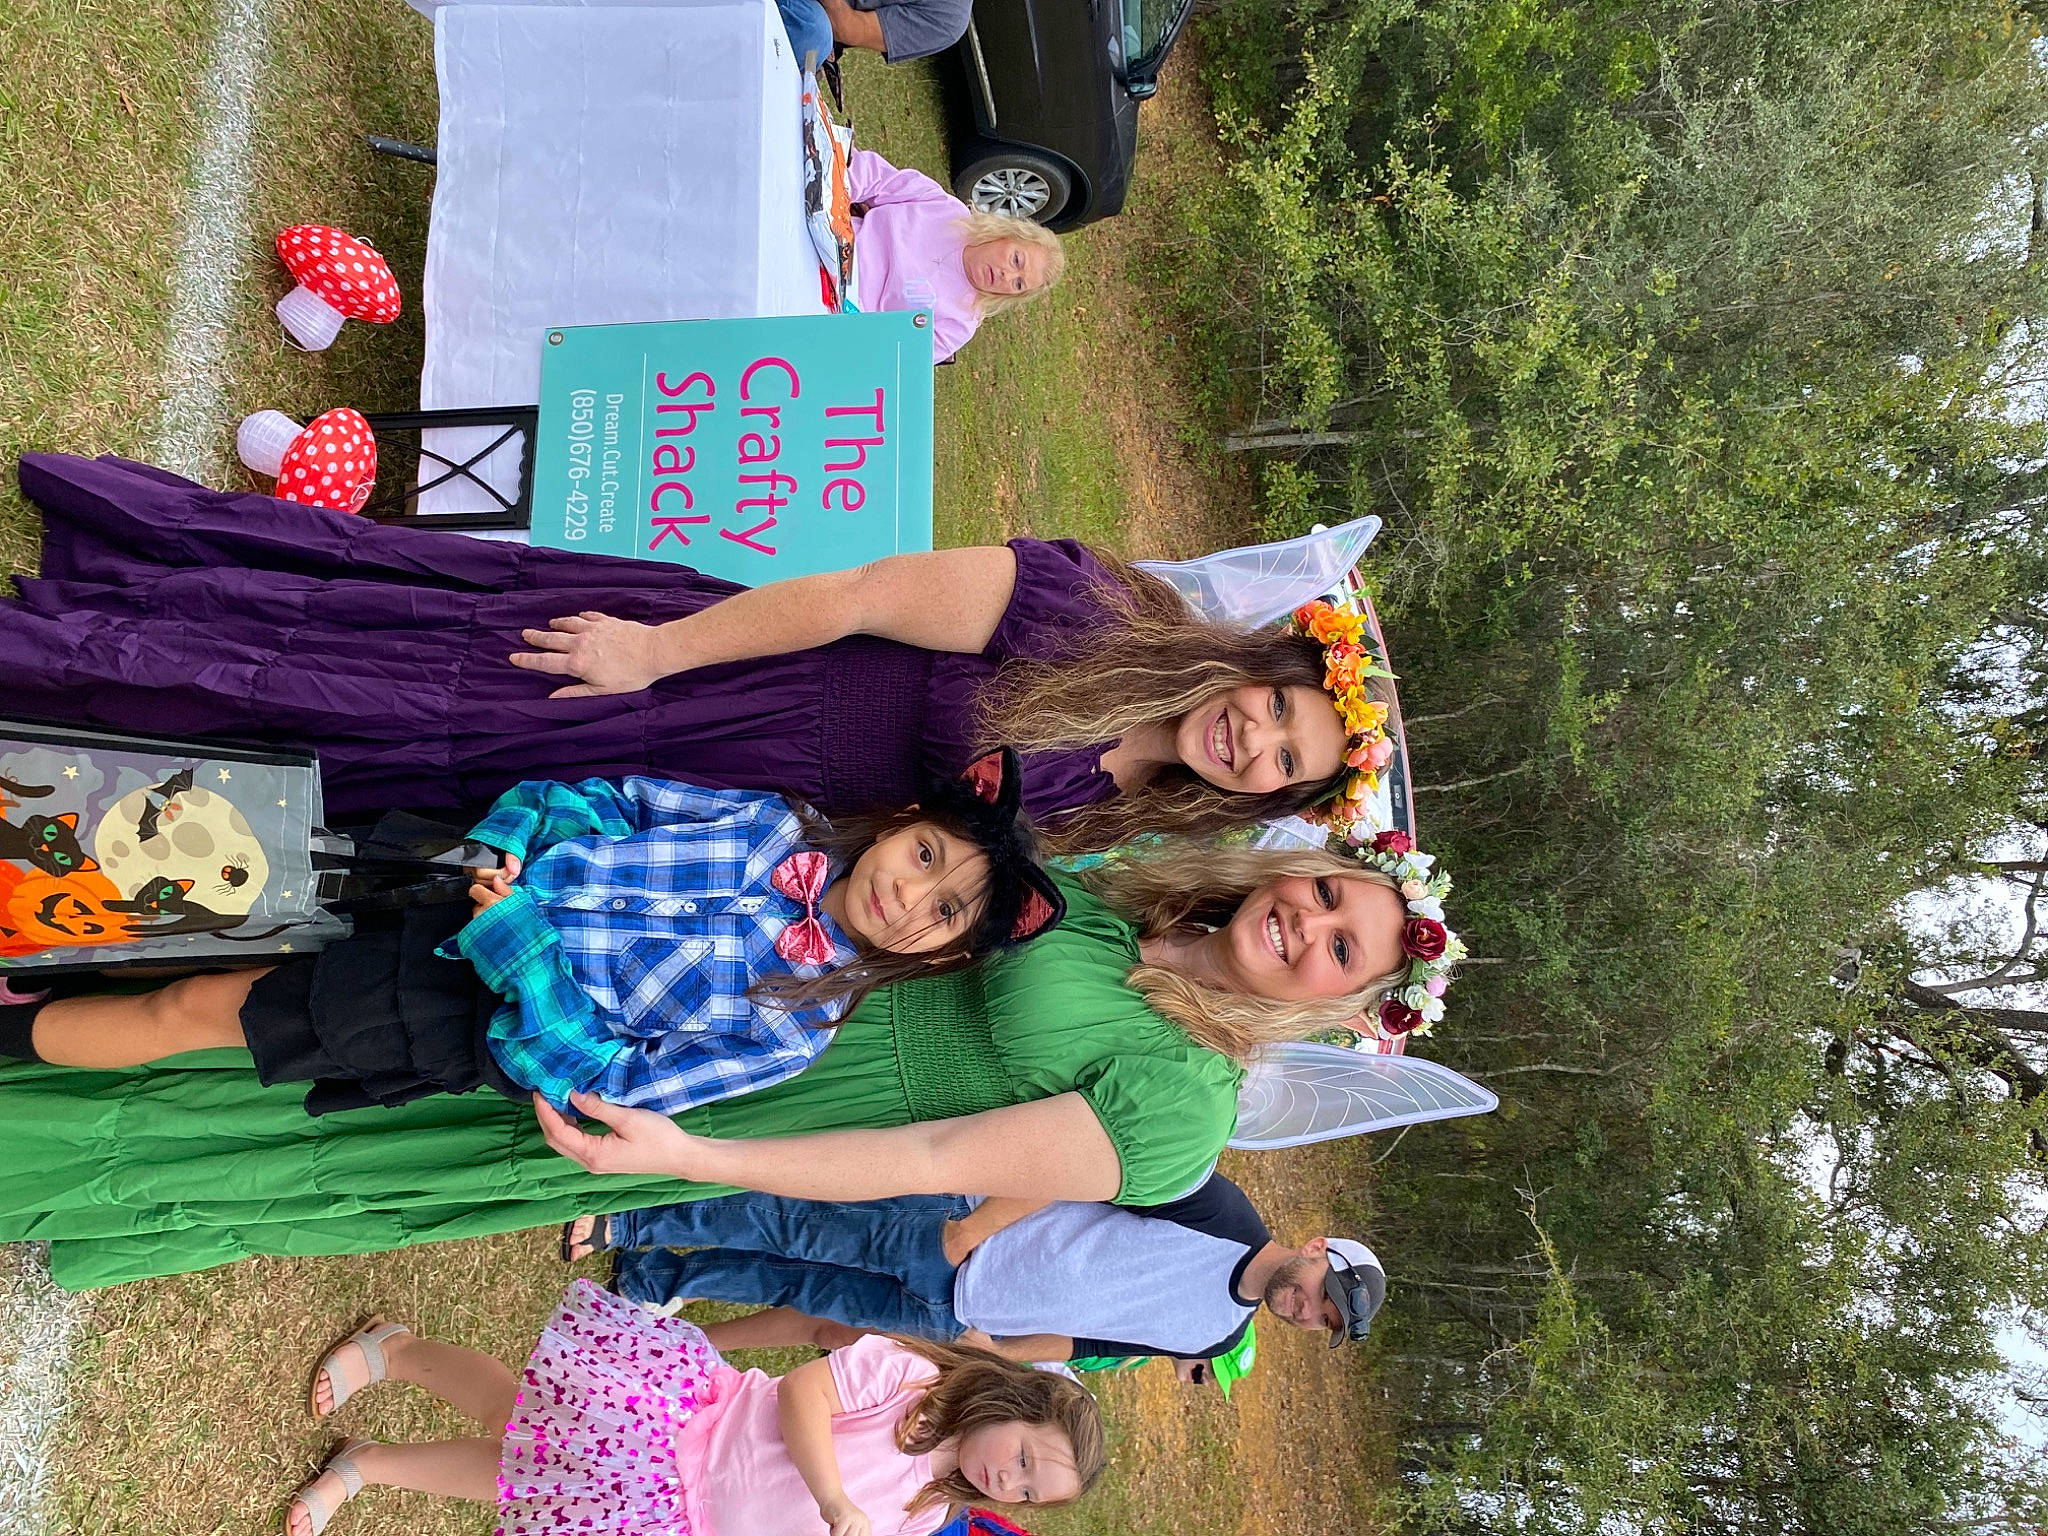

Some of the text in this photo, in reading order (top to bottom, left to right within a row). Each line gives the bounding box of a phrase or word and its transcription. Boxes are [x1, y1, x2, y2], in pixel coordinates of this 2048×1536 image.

[564, 389, 597, 541] (850)676-4229
[599, 393, 624, 533] Dream.Cut.Create
[649, 371, 716, 550] Shack
[719, 357, 800, 556] Crafty
[822, 388, 885, 511] The
